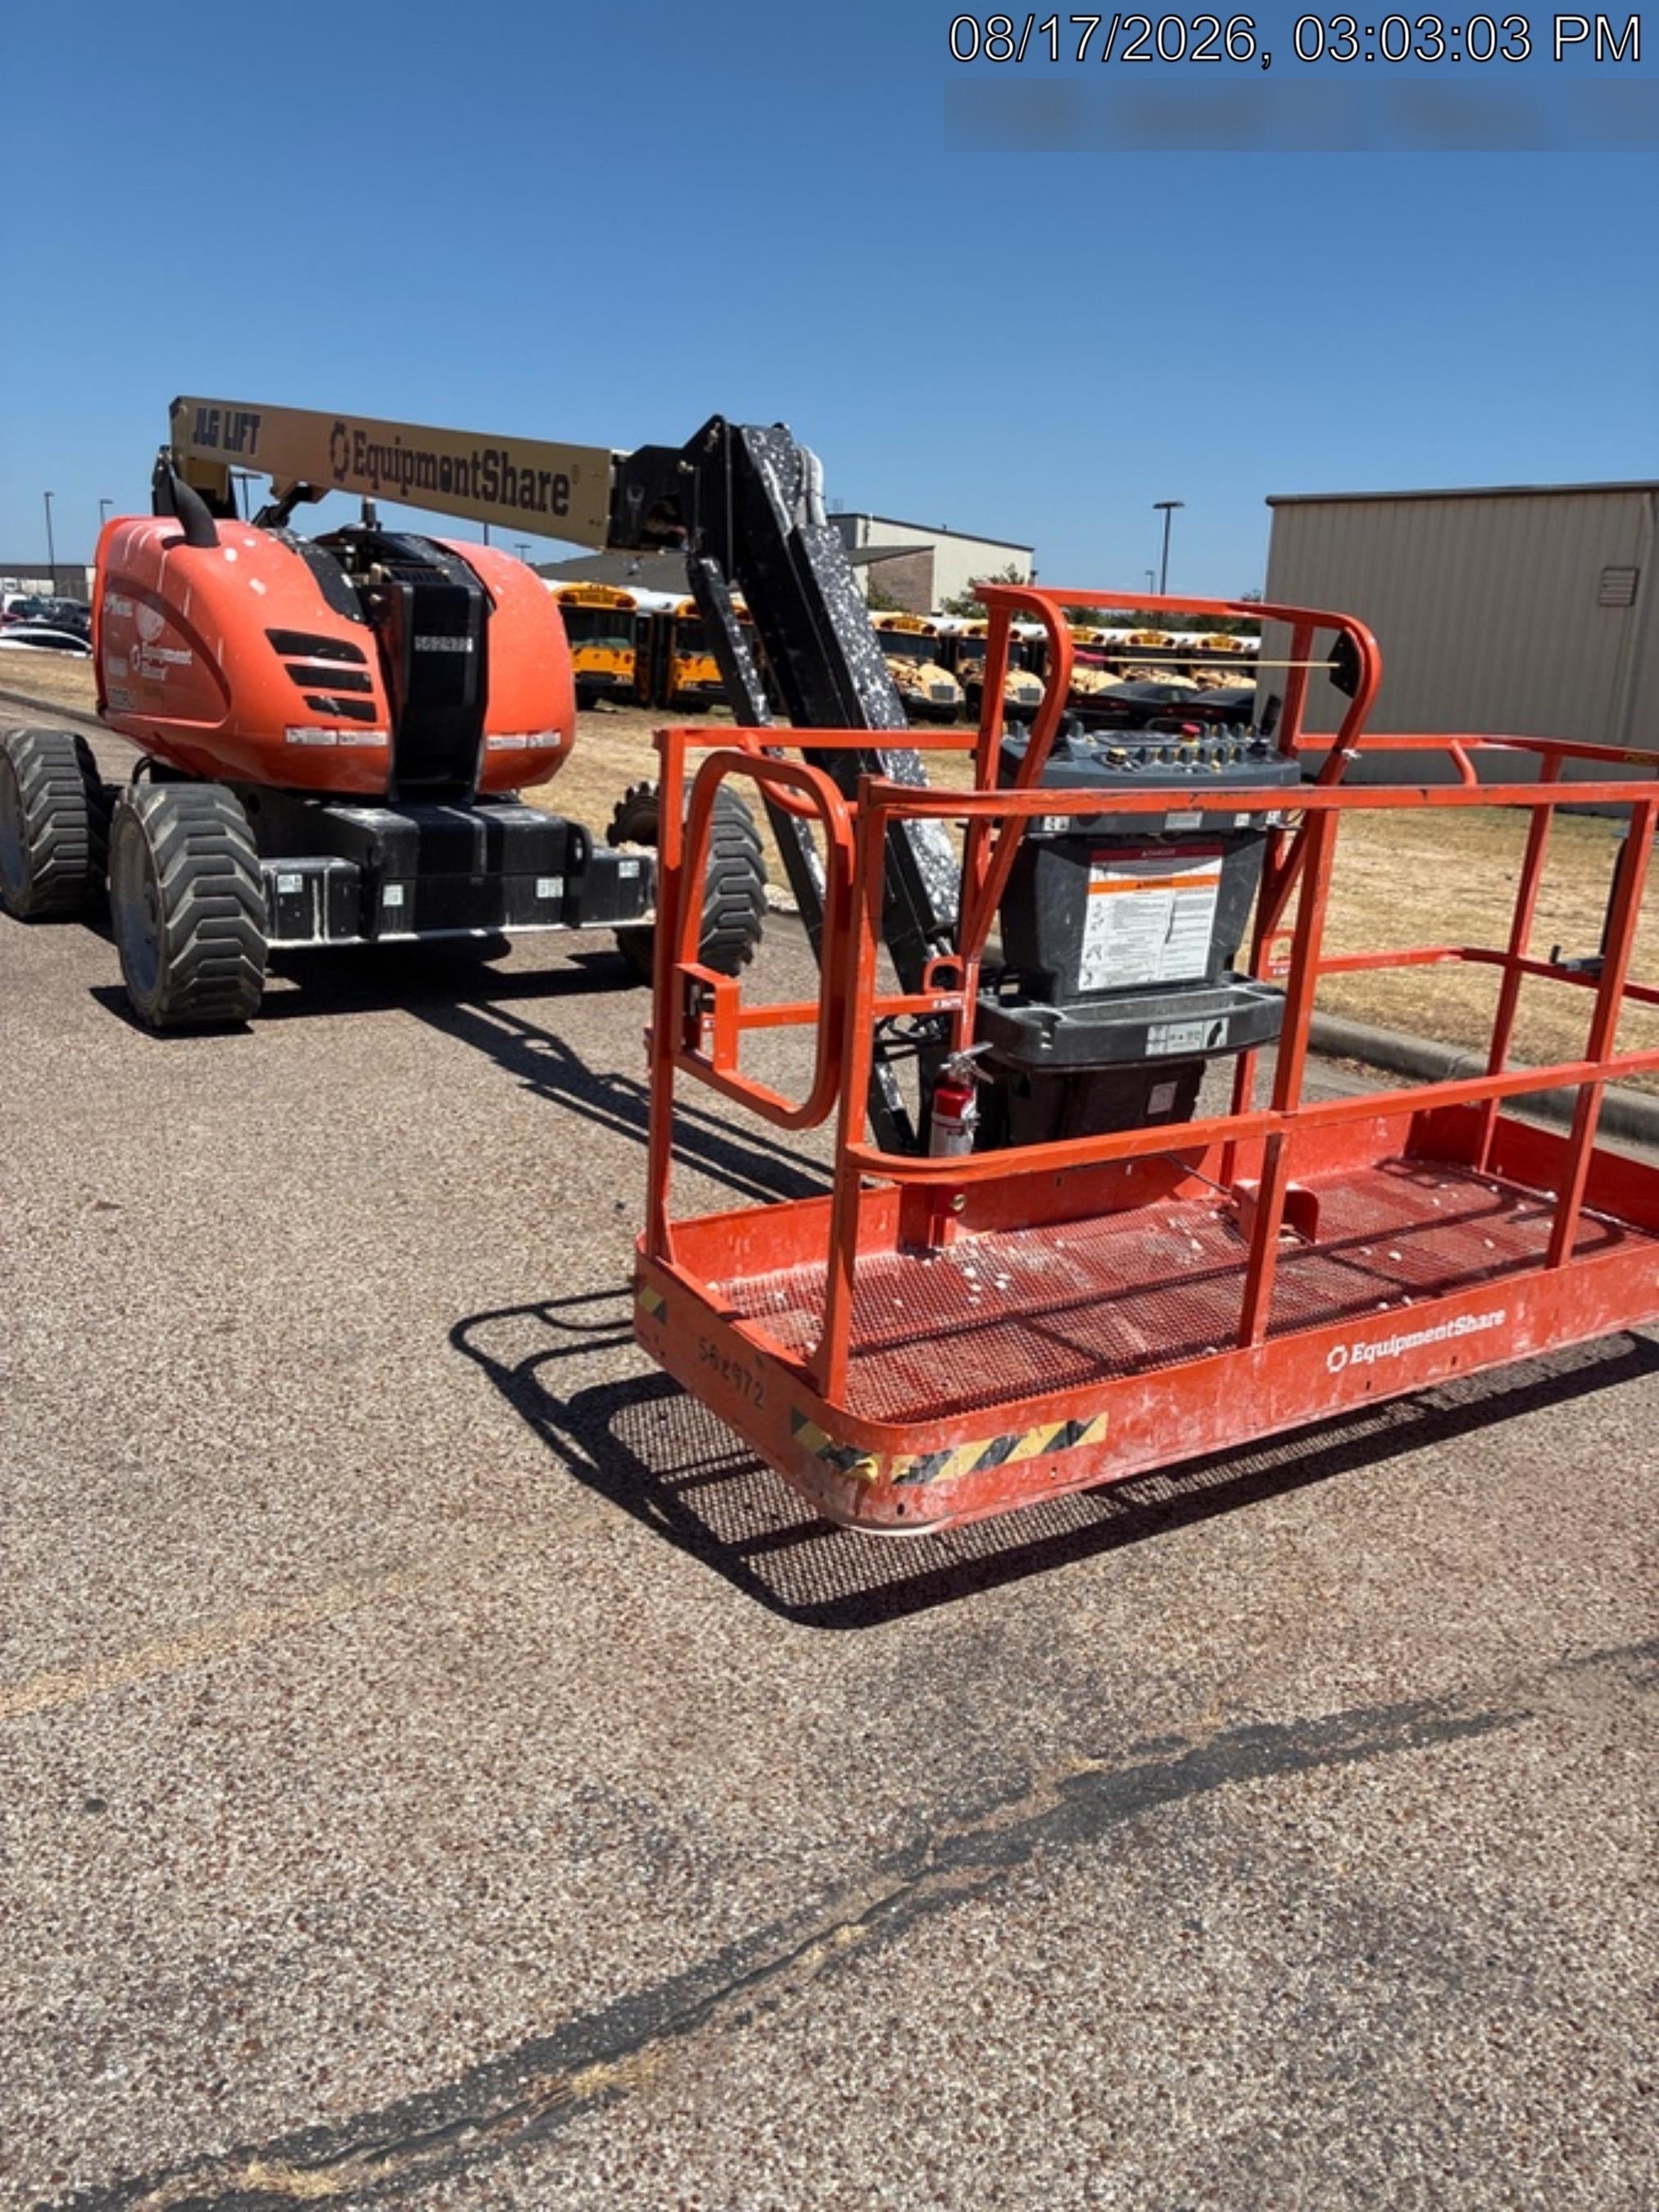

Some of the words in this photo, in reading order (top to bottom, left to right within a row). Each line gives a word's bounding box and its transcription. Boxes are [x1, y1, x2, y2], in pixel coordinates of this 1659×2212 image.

[193, 407, 220, 447] JLG
[223, 410, 261, 455] LIFT
[353, 430, 571, 517] EquipmentShare
[1350, 1309, 1507, 1364] EquipmentShare
